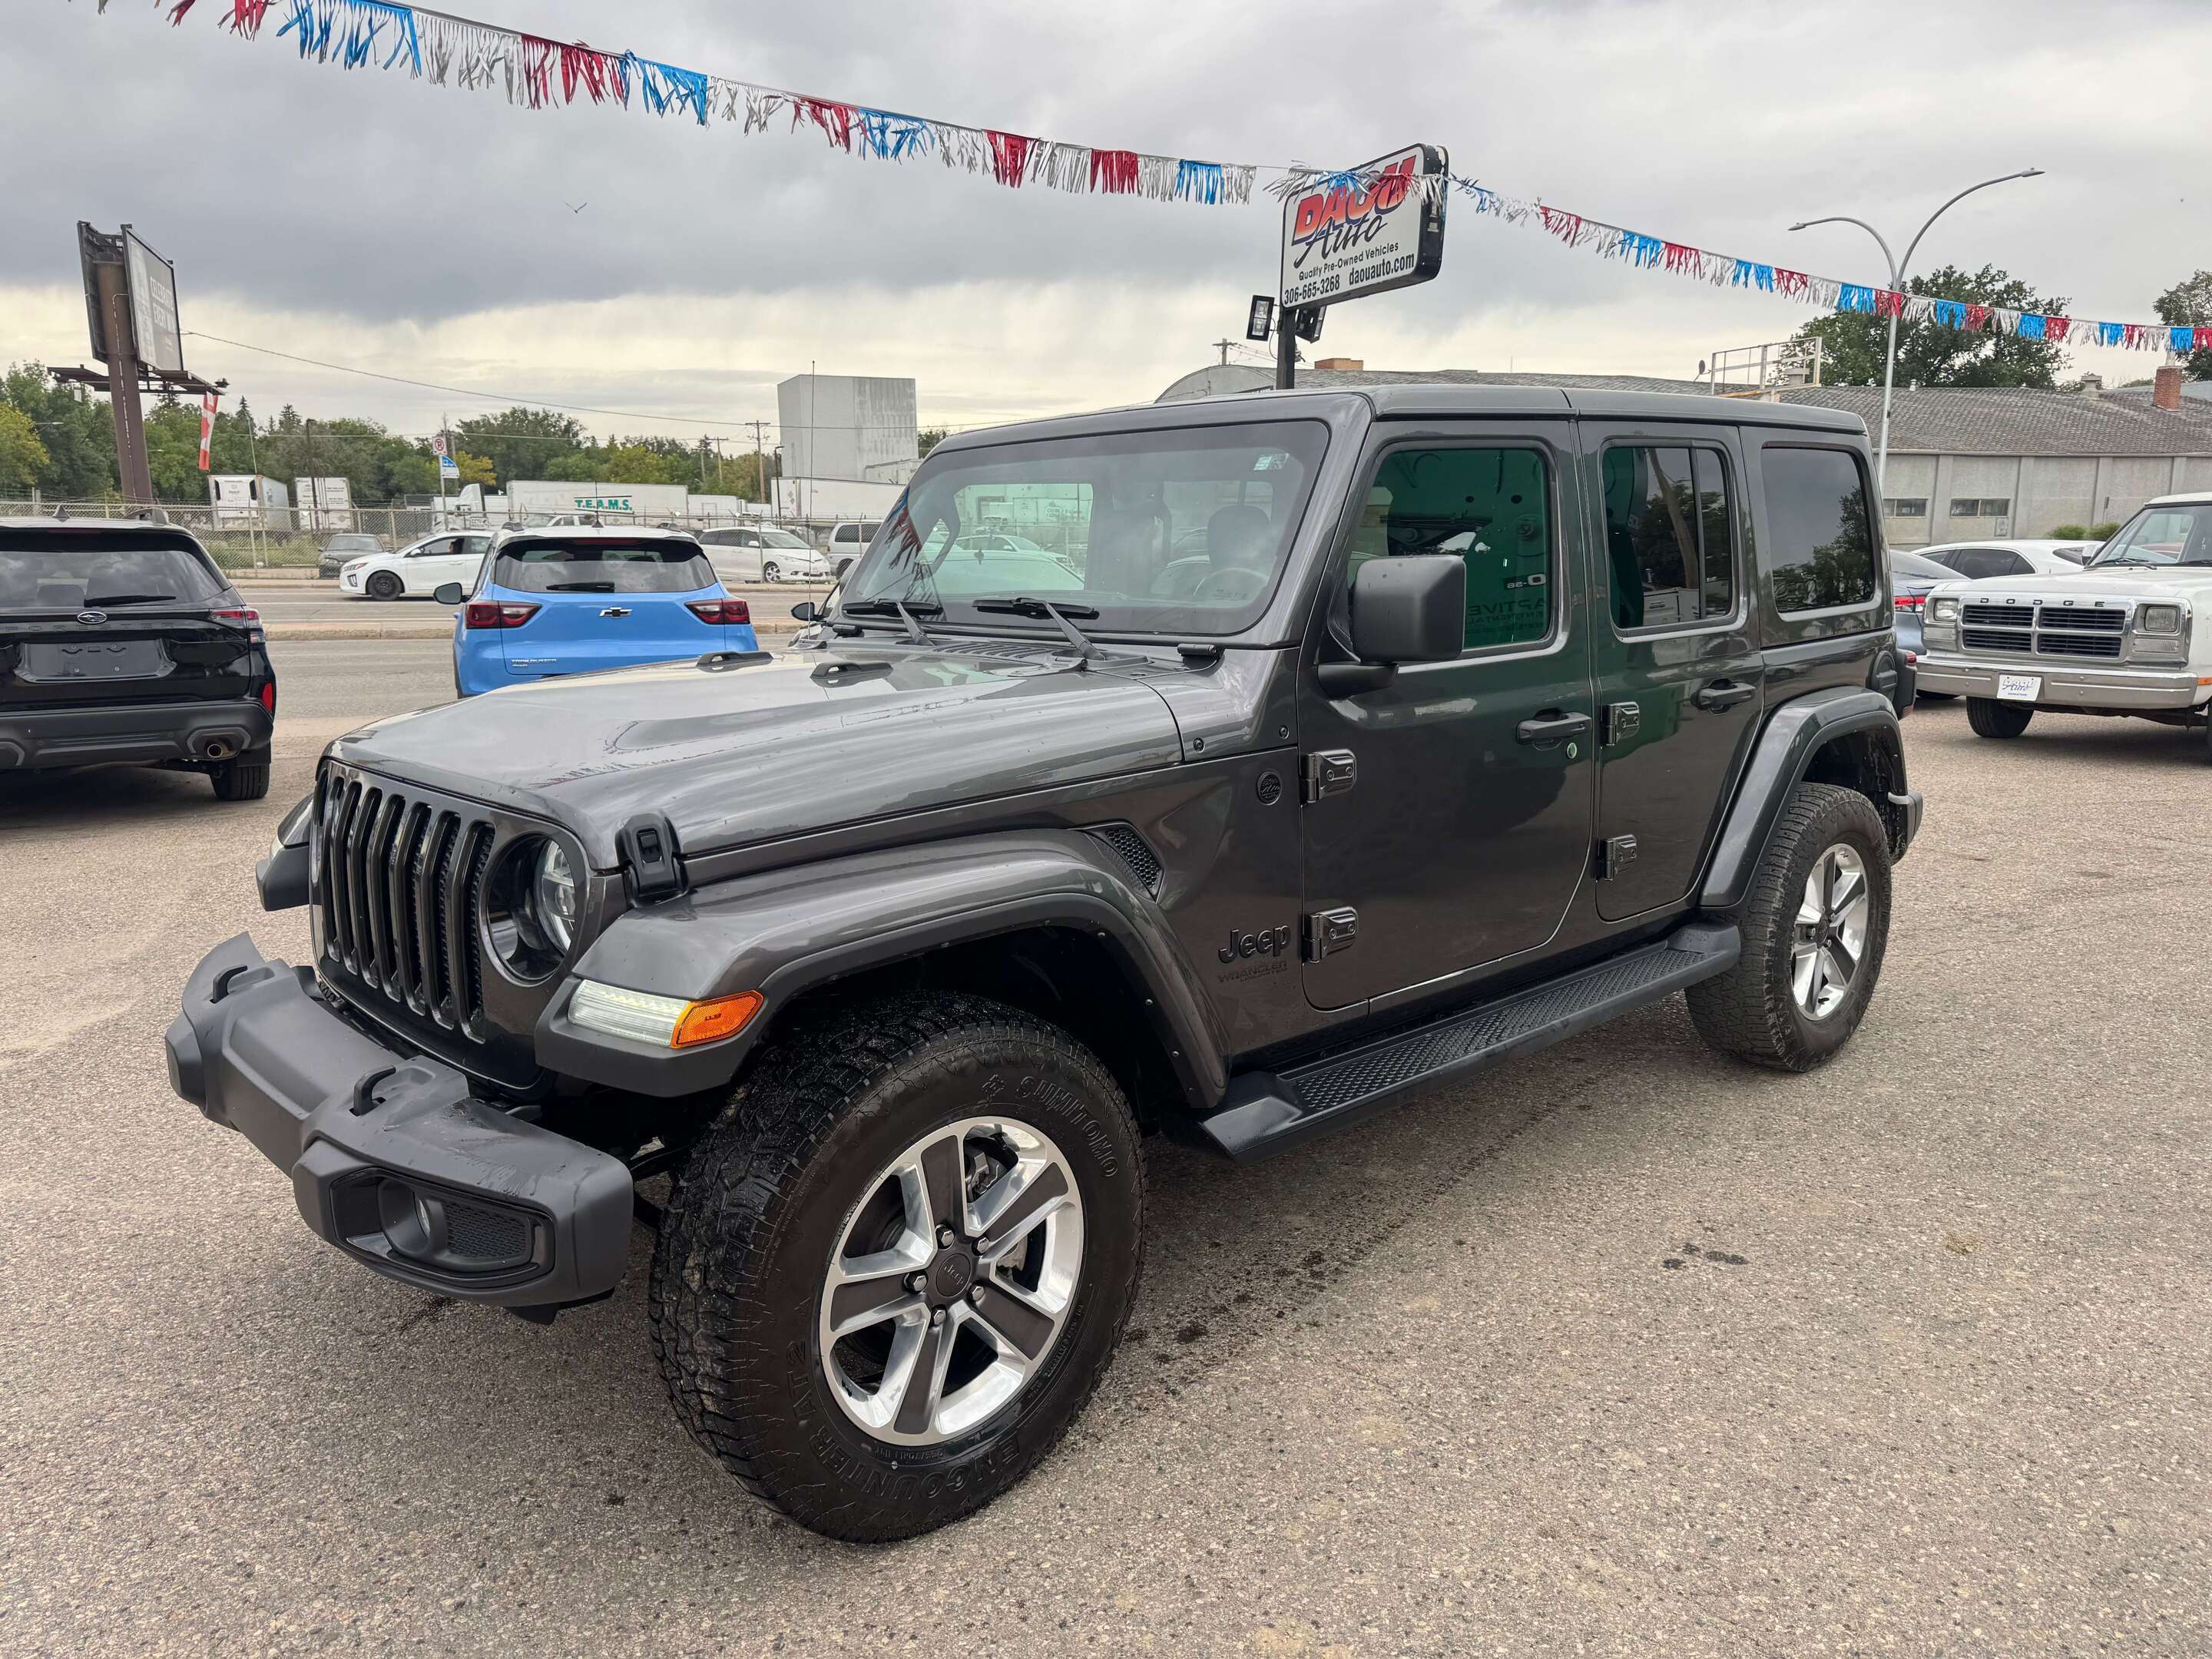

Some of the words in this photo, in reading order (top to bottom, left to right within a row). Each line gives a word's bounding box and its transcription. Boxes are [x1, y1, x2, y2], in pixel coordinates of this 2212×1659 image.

[1293, 215, 1388, 268] Auto
[1299, 264, 1323, 280] Quality
[1323, 251, 1363, 273] Pre-Owned
[1366, 242, 1399, 260] Vehicles
[1284, 274, 1339, 305] 306-665-3268
[1349, 253, 1415, 286] daouauto.com
[575, 498, 633, 511] T.E.A.M.S.
[1980, 598, 2105, 608] DODGE
[1218, 925, 1291, 964] Jeep
[1015, 1075, 1119, 1178] SUMITOMO
[809, 1425, 1021, 1500] ENCOUNTER
